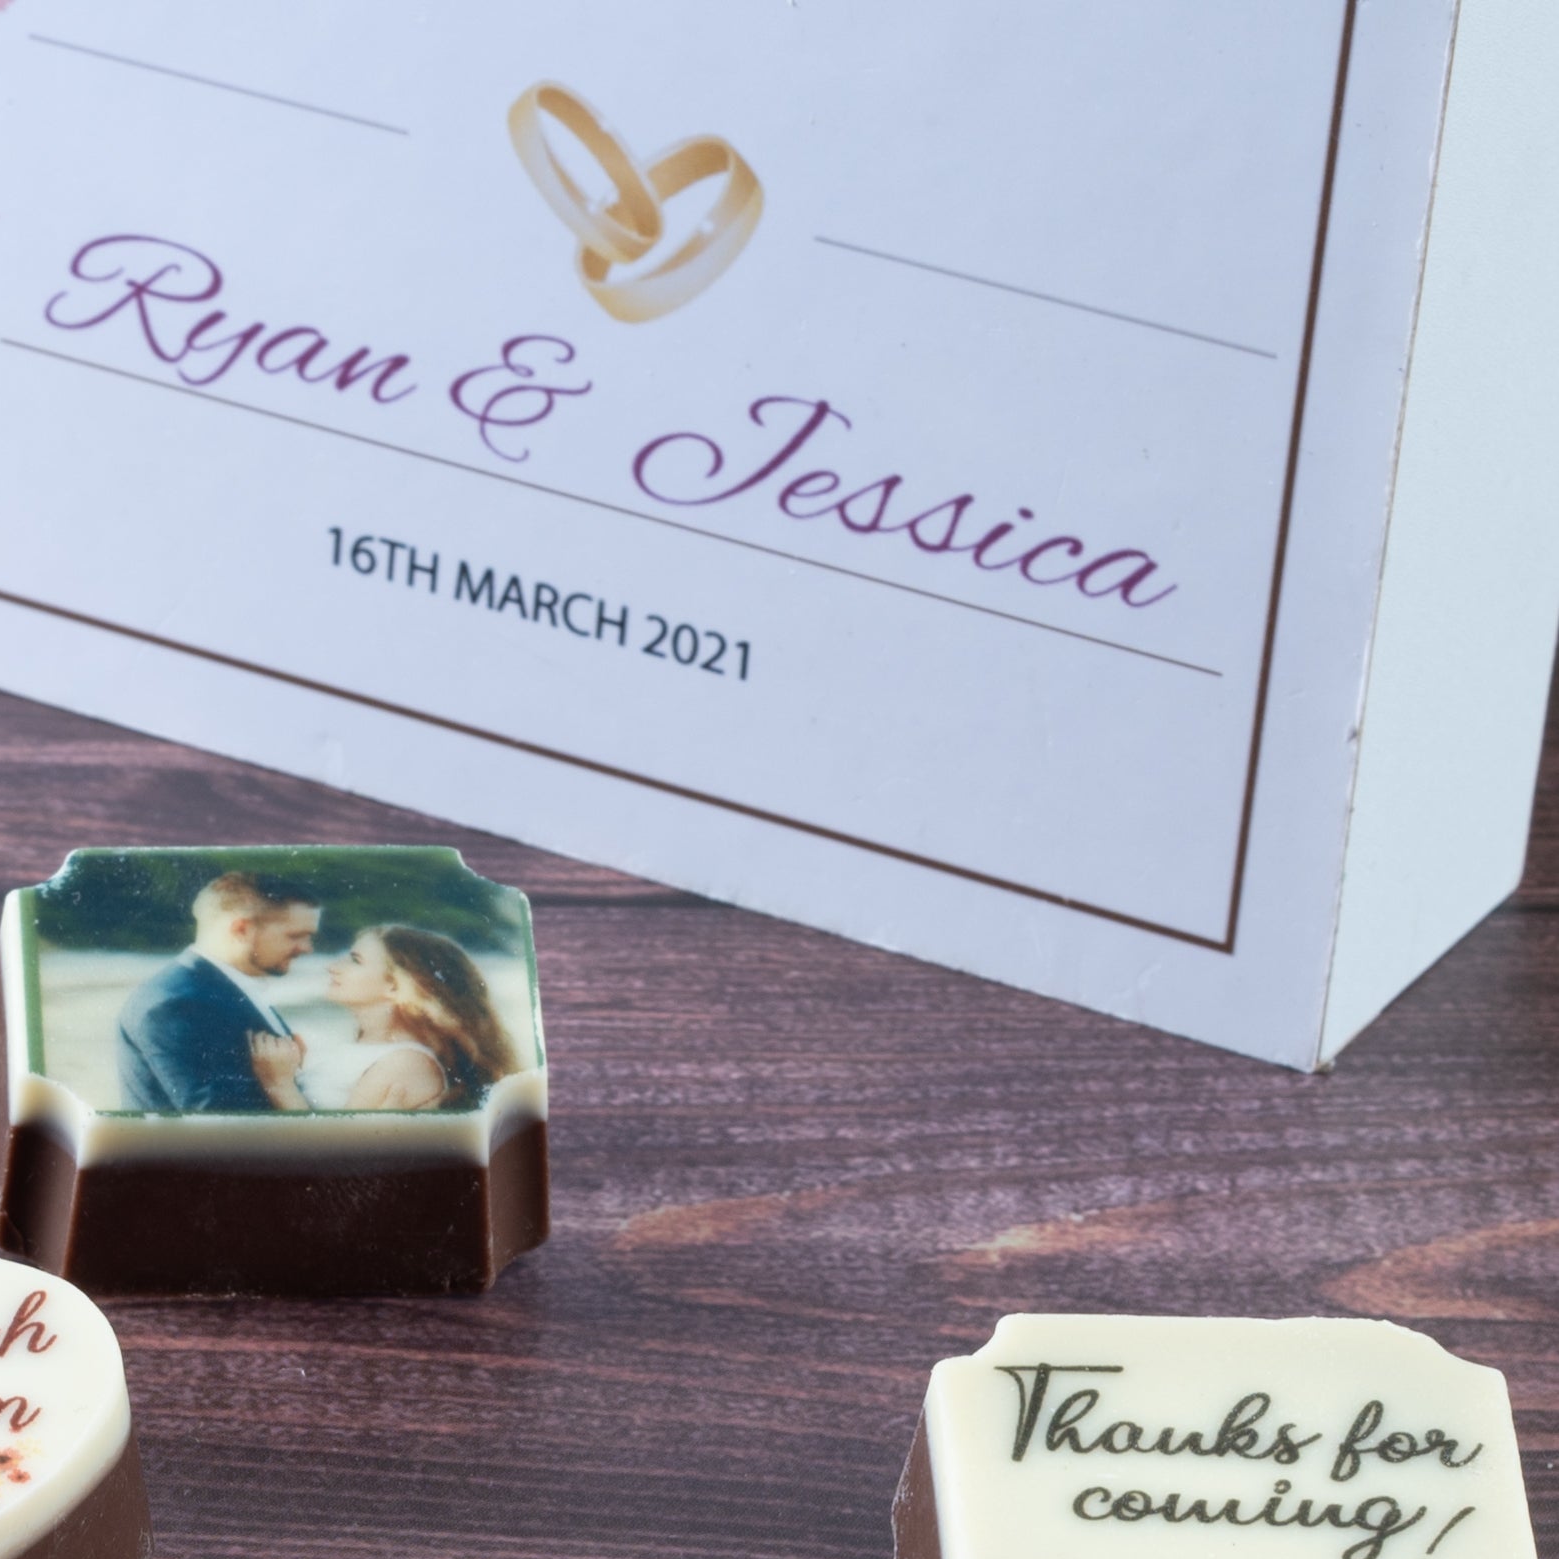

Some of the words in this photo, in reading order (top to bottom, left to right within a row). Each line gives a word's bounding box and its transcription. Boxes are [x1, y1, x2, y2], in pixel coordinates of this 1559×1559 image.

[45, 234, 417, 405] Ryan
[448, 334, 592, 462] &
[631, 396, 1178, 609] Jessica
[325, 526, 440, 595] 16TH
[452, 563, 631, 649] MARCH
[644, 613, 754, 682] 2021
[994, 1362, 1323, 1465] Thanks
[1330, 1399, 1484, 1482] for
